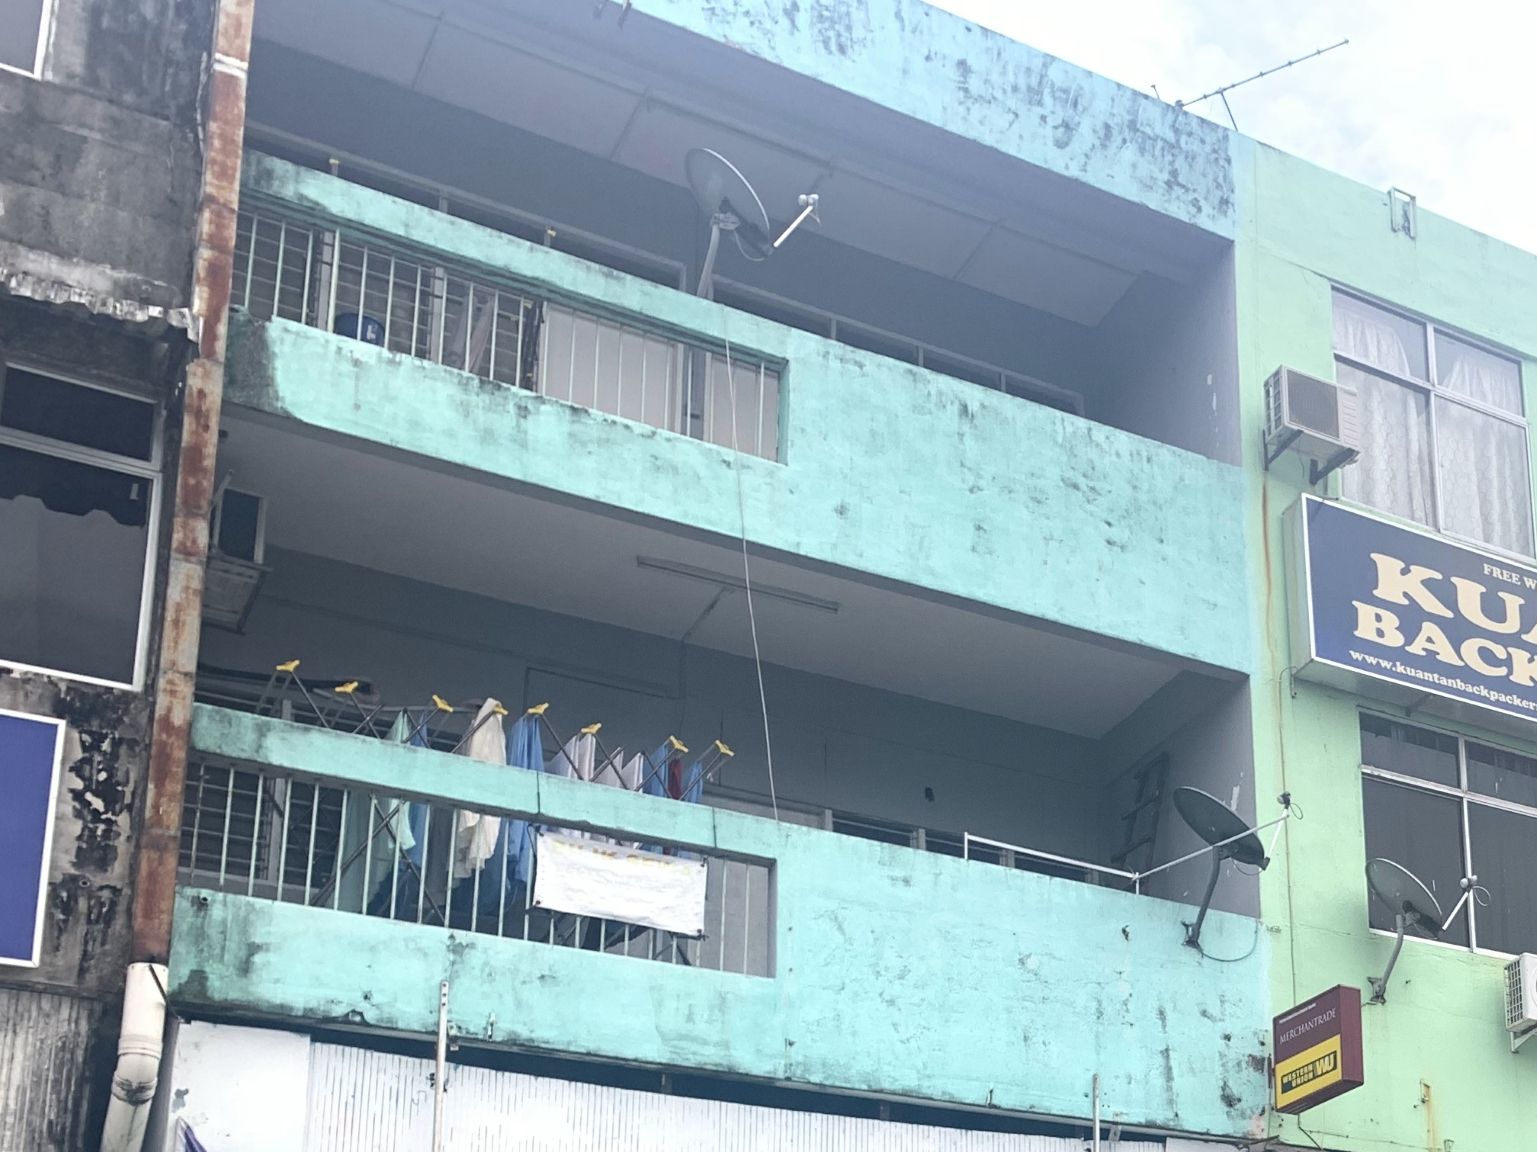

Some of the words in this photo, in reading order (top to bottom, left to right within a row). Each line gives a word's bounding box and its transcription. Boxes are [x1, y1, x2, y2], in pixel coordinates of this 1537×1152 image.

[1483, 564, 1521, 585] FREE
[1280, 1008, 1337, 1044] MERCHANTRADE
[1282, 1064, 1313, 1084] WESTERN
[1291, 1071, 1313, 1087] UNION
